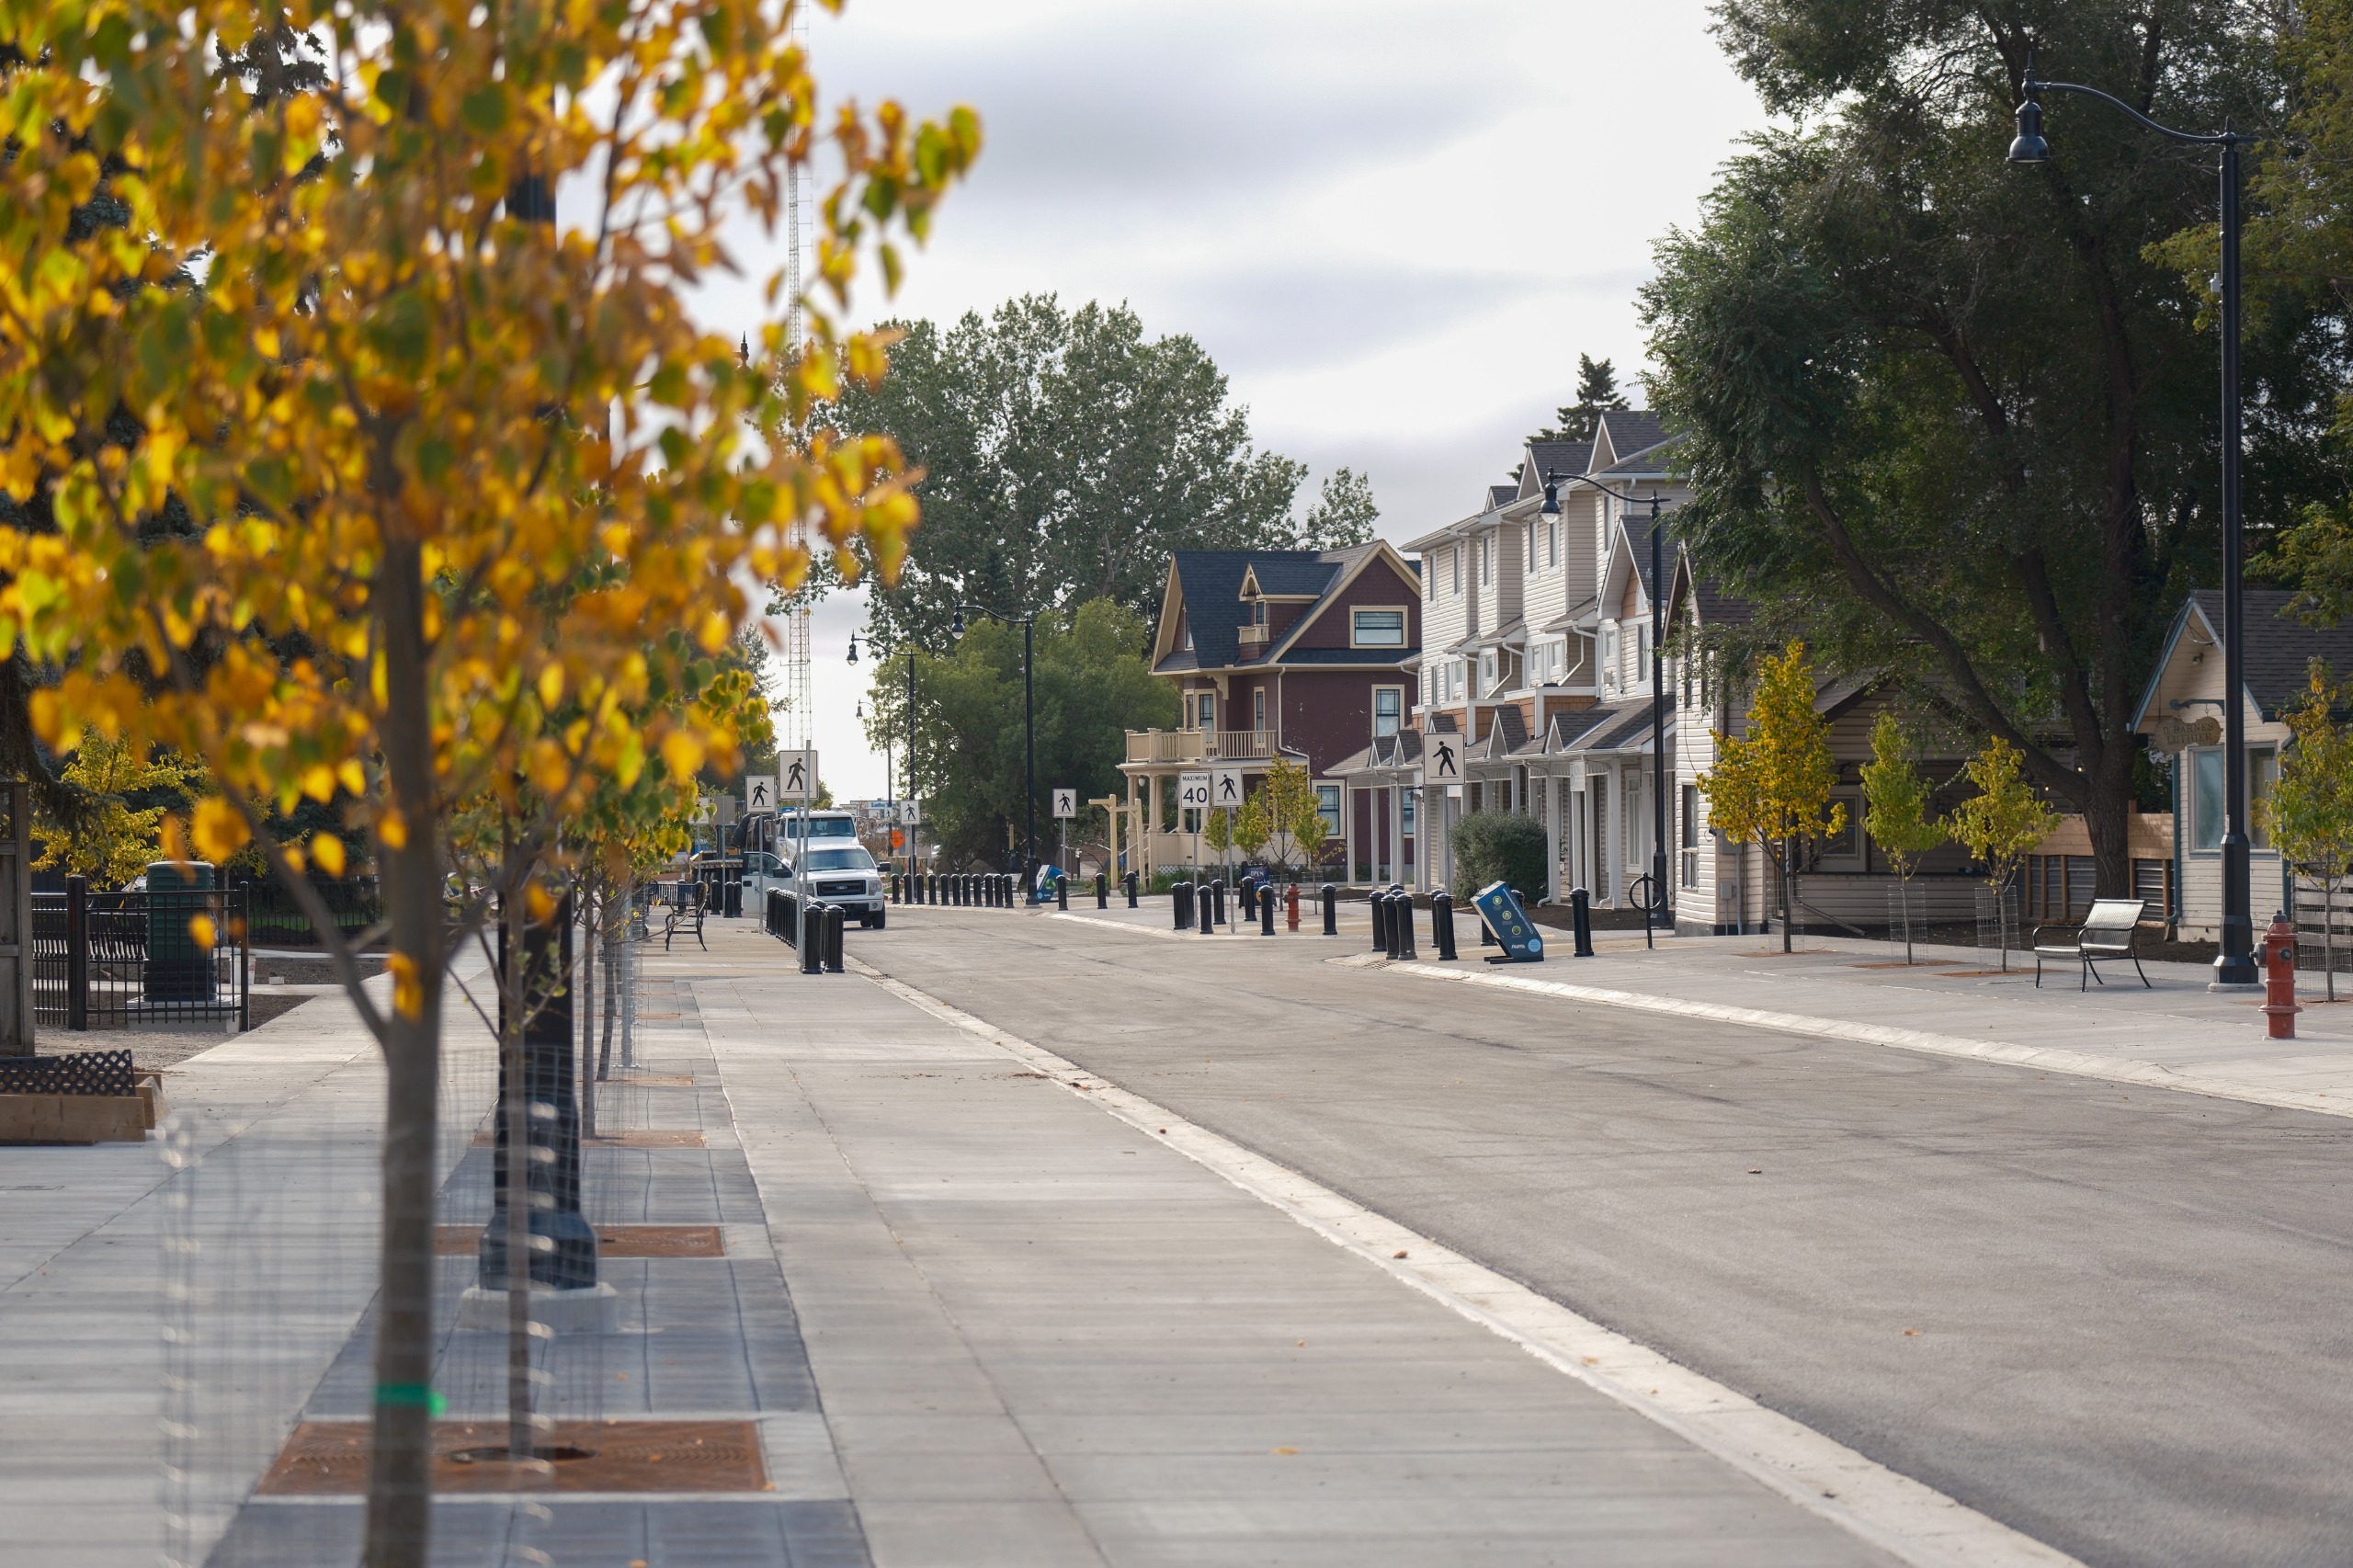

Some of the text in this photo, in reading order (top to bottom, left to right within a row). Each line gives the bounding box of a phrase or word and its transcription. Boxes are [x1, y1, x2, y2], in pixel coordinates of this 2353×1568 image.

[2174, 722, 2213, 734] BARNES
[2166, 733, 2211, 744] LUTHIER
[1183, 787, 1207, 802] 40
